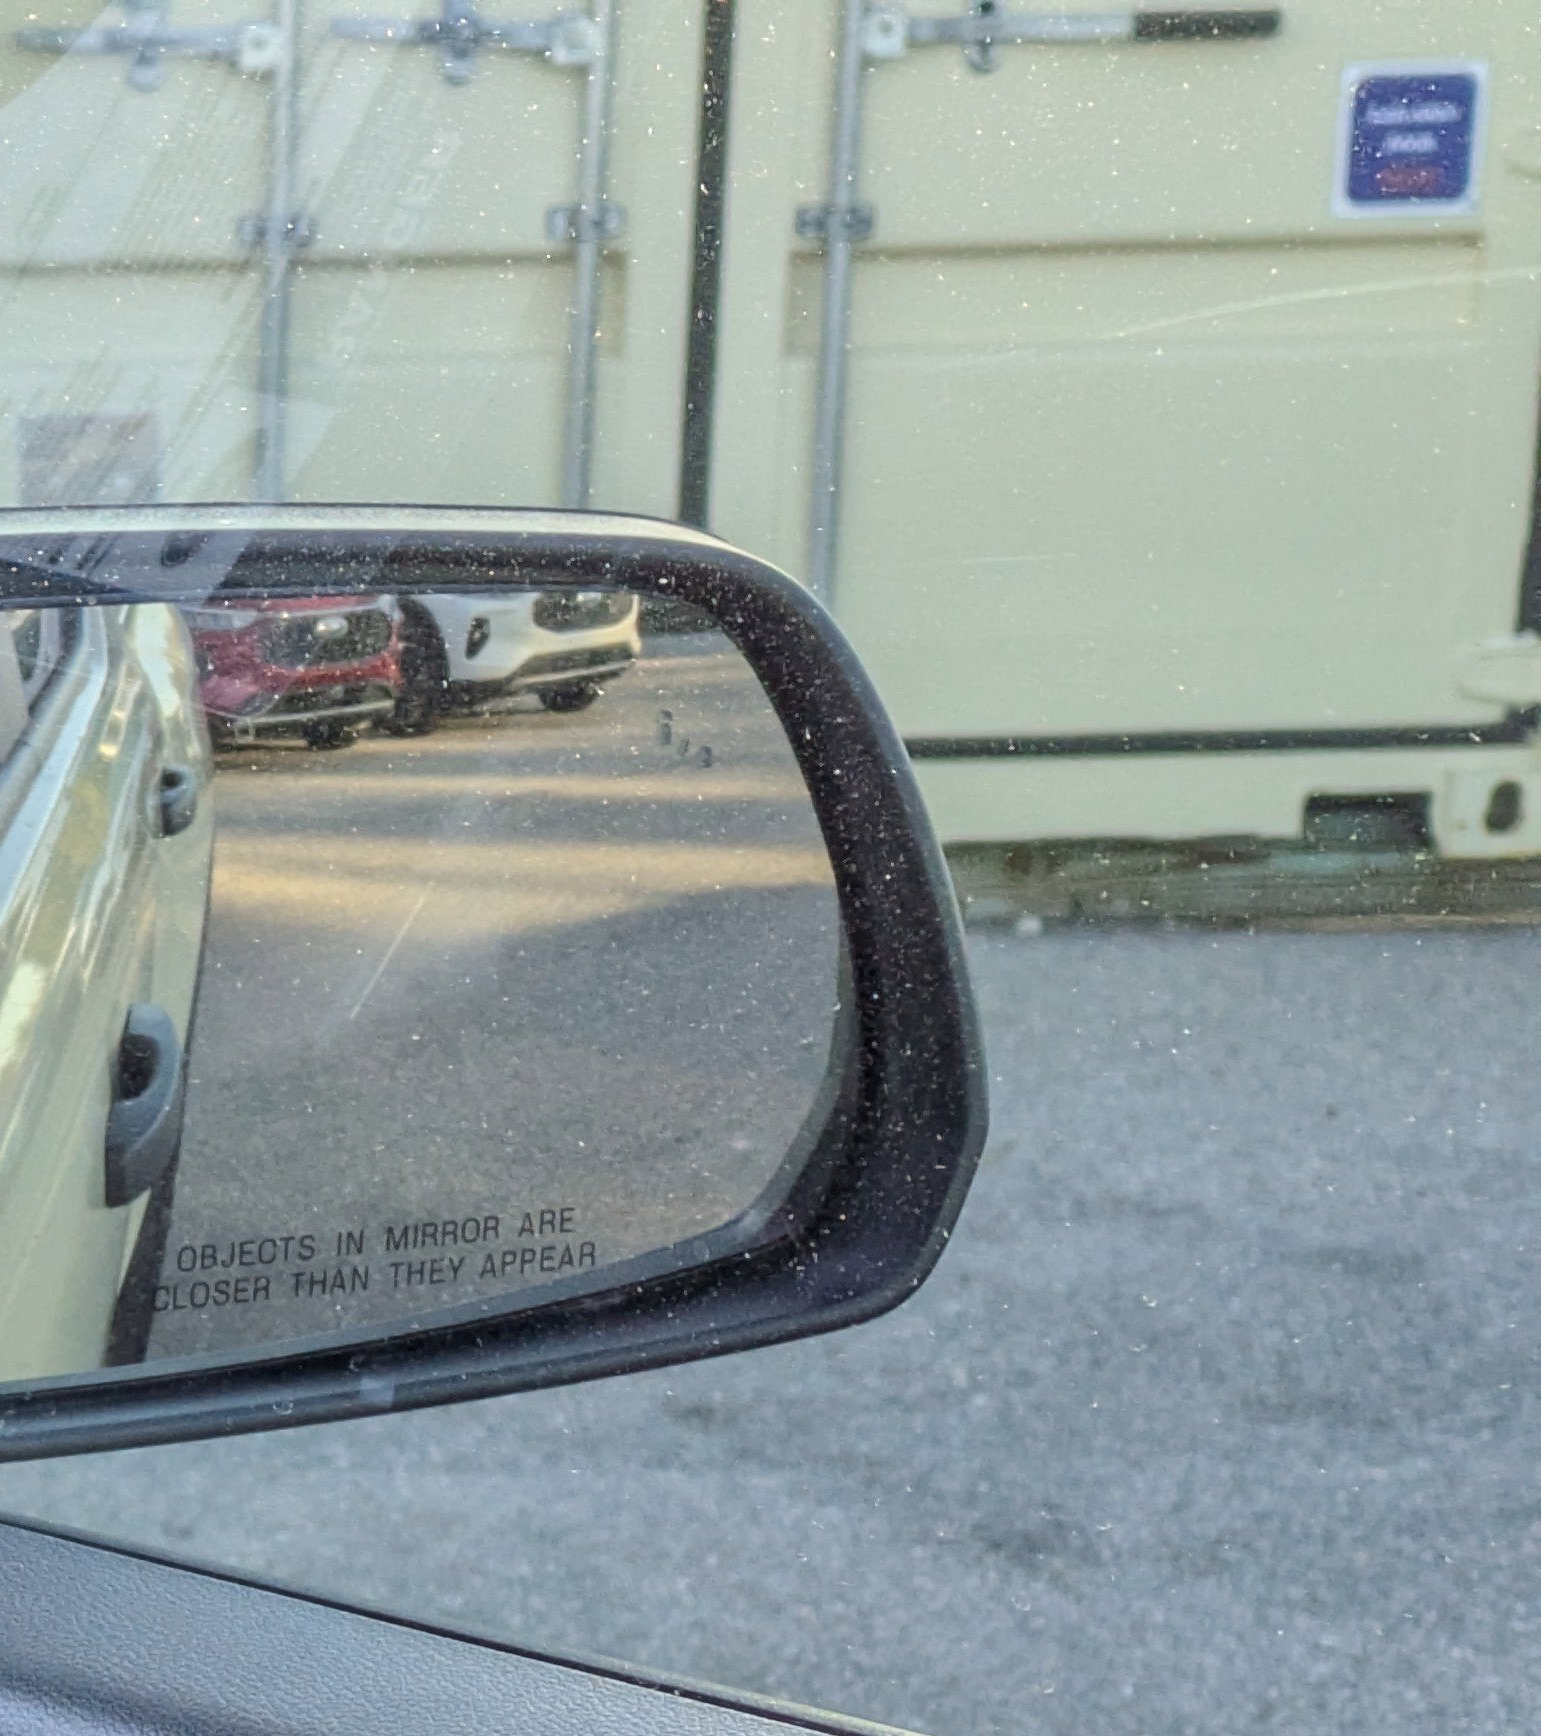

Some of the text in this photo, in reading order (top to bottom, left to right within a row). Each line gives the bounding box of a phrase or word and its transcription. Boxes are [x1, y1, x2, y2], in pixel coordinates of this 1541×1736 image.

[178, 1207, 575, 1272] OBJECTS IN MIRROR ARE
[153, 1241, 596, 1312] CLOSER THAN THEY APPEAR
